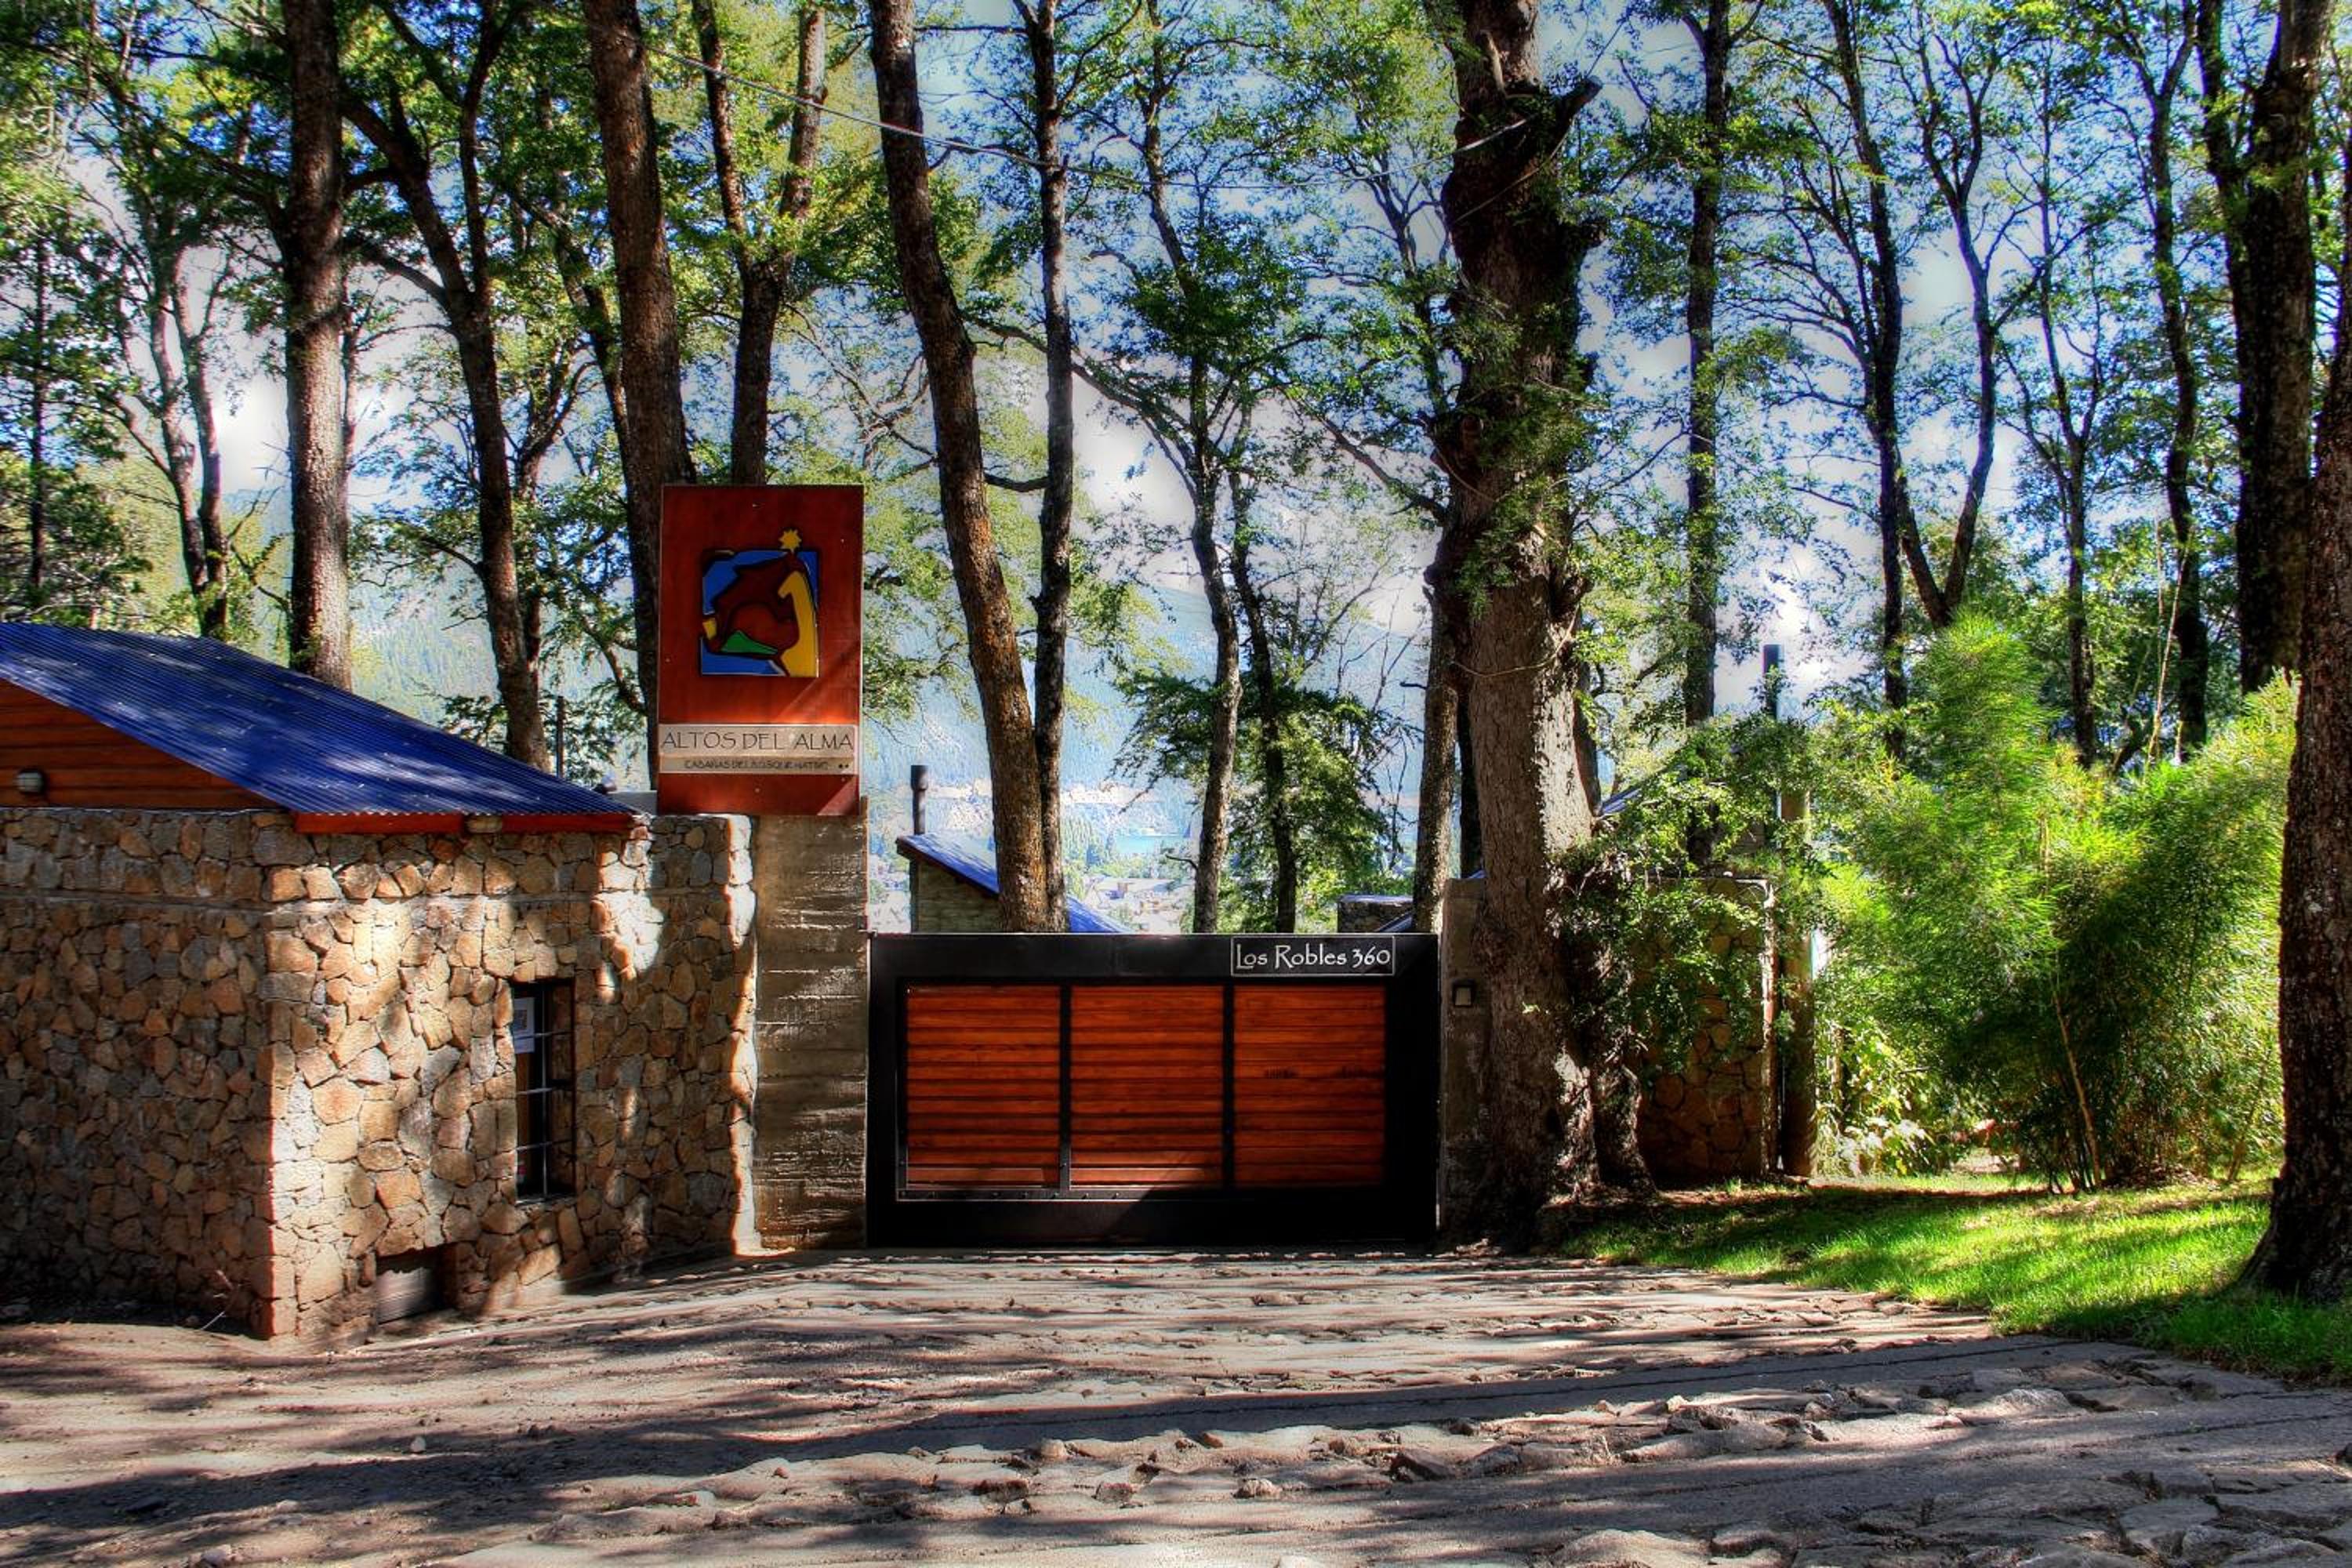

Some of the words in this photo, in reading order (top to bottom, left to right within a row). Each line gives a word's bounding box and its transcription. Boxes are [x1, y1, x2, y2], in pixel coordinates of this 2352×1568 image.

[662, 731, 737, 750] ALTOS
[742, 733, 783, 750] DEL
[793, 733, 854, 750] ALMA
[1236, 943, 1268, 970] Los
[1275, 942, 1348, 970] Robles
[1352, 946, 1391, 969] 360
